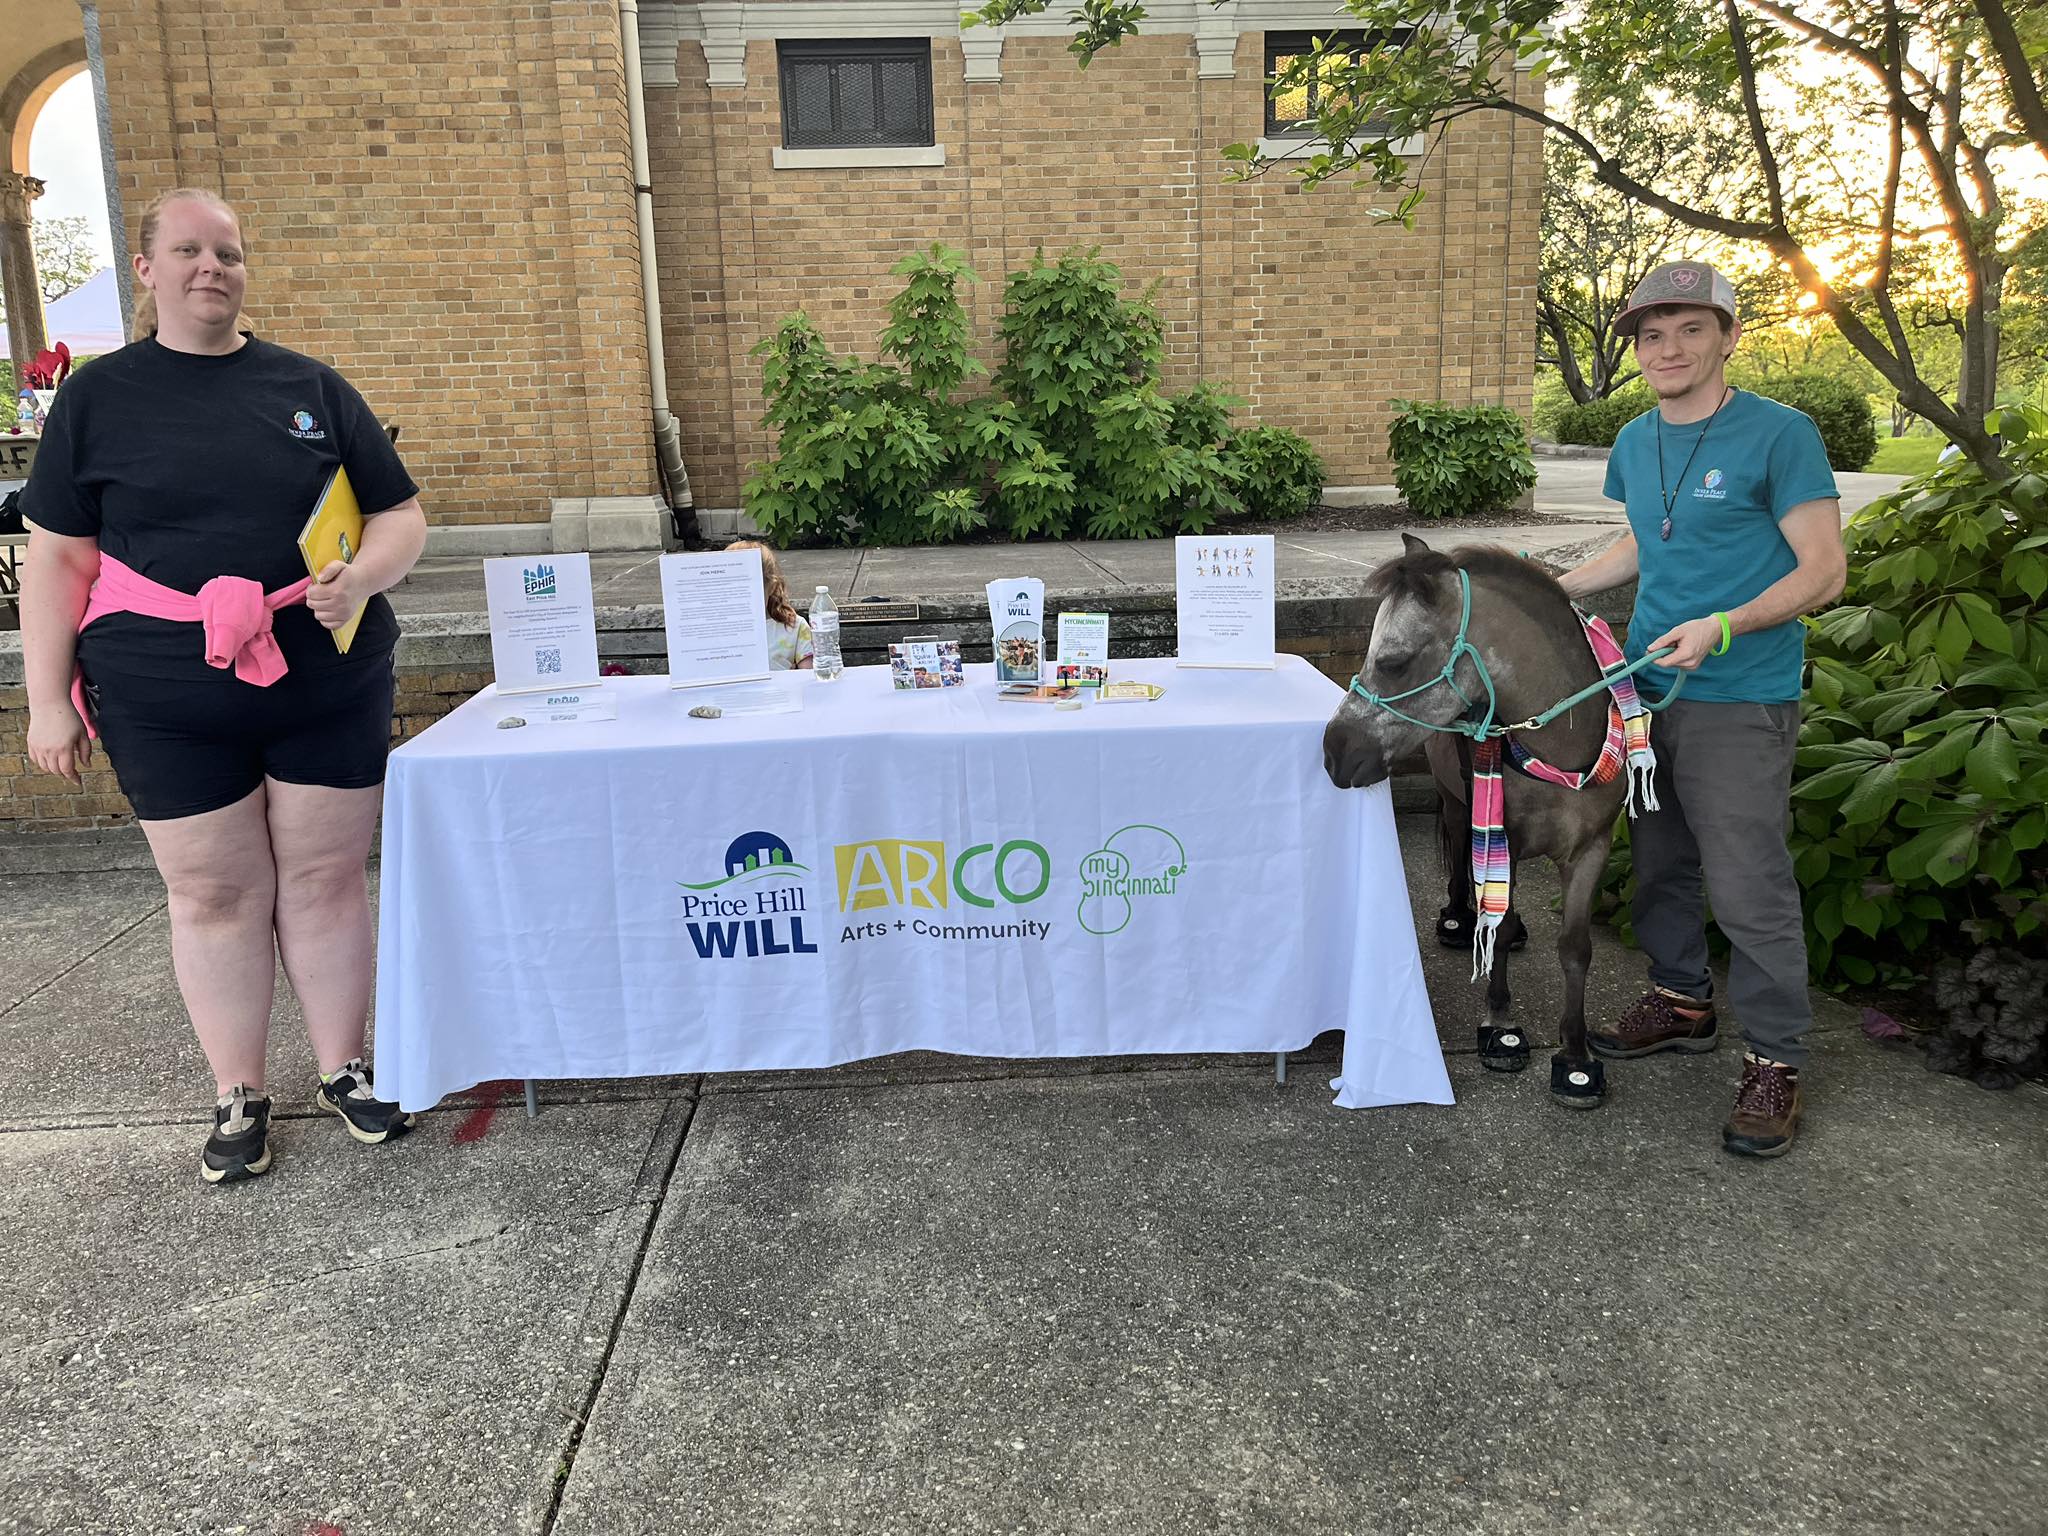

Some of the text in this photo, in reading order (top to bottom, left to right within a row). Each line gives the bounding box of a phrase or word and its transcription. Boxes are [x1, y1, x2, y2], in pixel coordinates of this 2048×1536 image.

[1008, 608, 1031, 616] WILL
[836, 839, 1051, 913] ARCO
[1088, 858, 1120, 879] my
[681, 887, 806, 918] Price Hill
[685, 916, 818, 959] WILL
[840, 919, 1051, 943] Arts + Community
